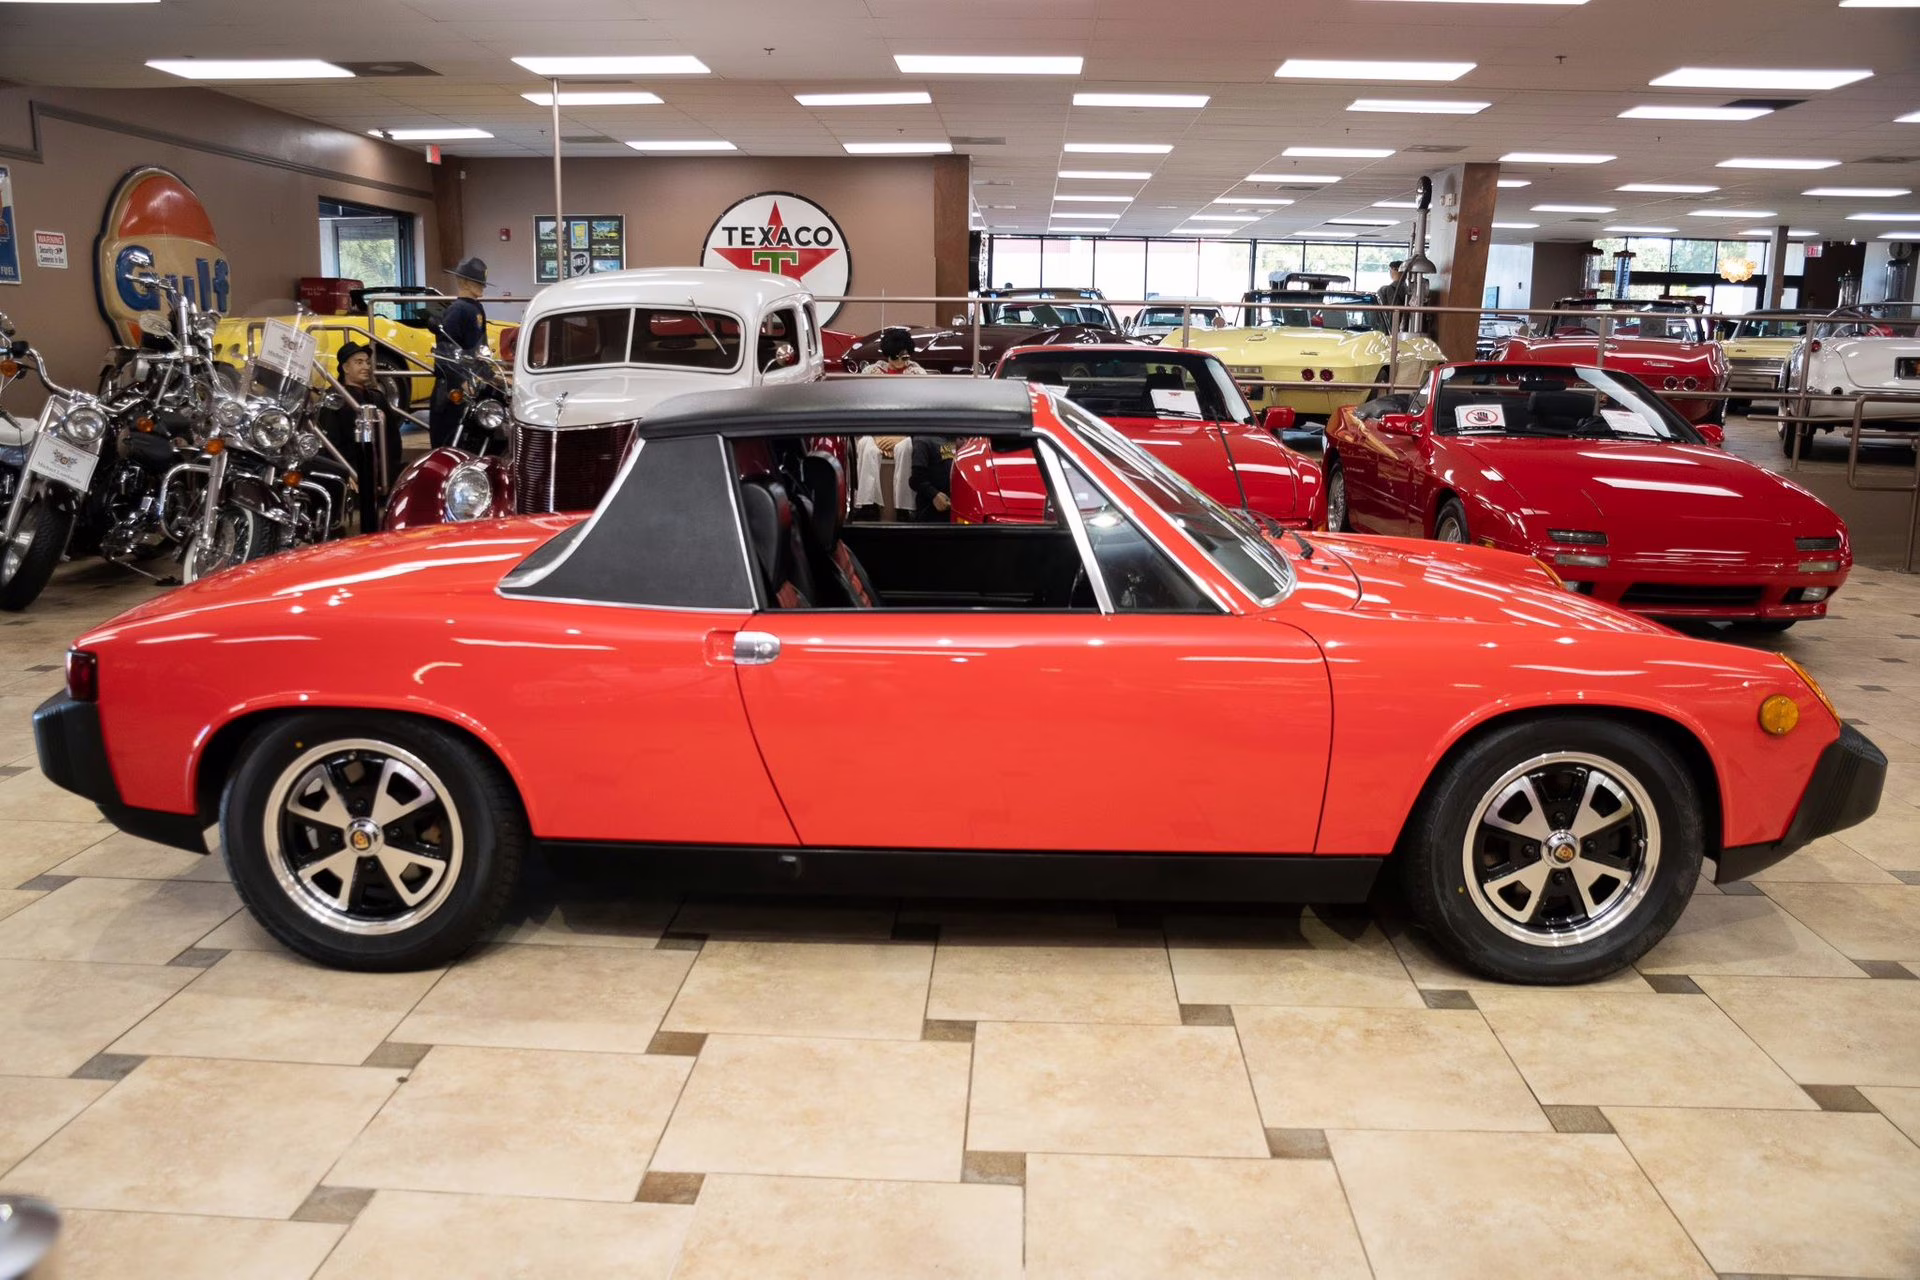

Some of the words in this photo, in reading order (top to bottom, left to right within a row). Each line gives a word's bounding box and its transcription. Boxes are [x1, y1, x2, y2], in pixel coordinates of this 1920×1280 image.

[722, 226, 833, 246] TEXACO
[0, 266, 15, 276] FUEL
[115, 245, 229, 312] Gulf
